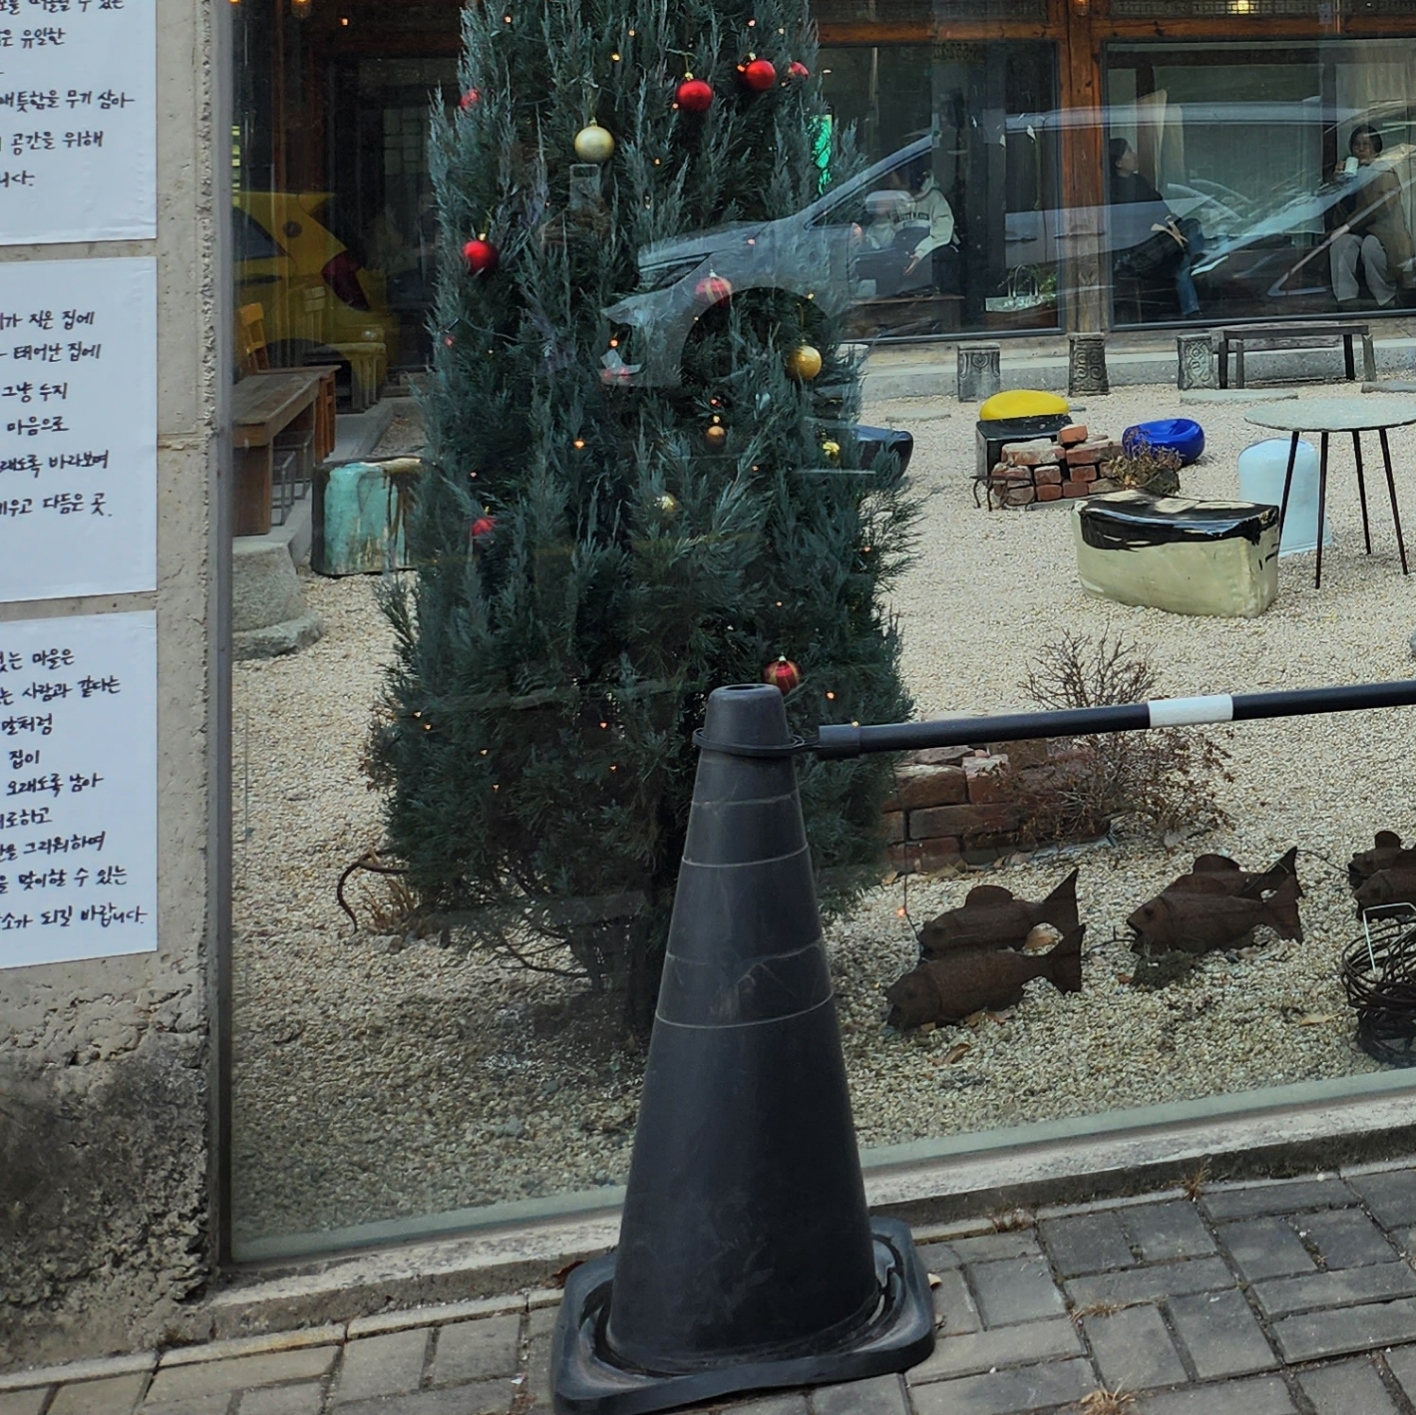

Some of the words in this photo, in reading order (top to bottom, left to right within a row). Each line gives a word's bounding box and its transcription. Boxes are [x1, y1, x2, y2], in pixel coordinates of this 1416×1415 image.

[20, 27, 66, 49] 유일한
[65, 90, 92, 109] 무기
[97, 89, 135, 109] 삼아
[11, 131, 55, 156] 공간을
[62, 130, 103, 148] 위해
[0, 312, 23, 330] 가
[28, 310, 54, 330] 지은
[62, 309, 95, 330] 집에
[13, 344, 63, 362] 태어난
[67, 342, 101, 362] 집에
[1, 383, 33, 403] 그냥
[7, 416, 70, 436] 마음으로
[43, 493, 84, 514] 다듬은
[32, 648, 74, 670] 마을은
[77, 675, 121, 696] 같다는
[1, 713, 52, 736] 말처럼
[9, 749, 40, 770] 집이
[6, 773, 64, 798] 오래도록
[69, 773, 104, 793] 남아
[0, 807, 53, 829] 로하고
[18, 868, 67, 891] 맞이할
[74, 867, 89, 887] 수
[96, 865, 127, 885] 있는
[40, 905, 73, 927] 되길
[80, 902, 148, 928] 바랍니다.
